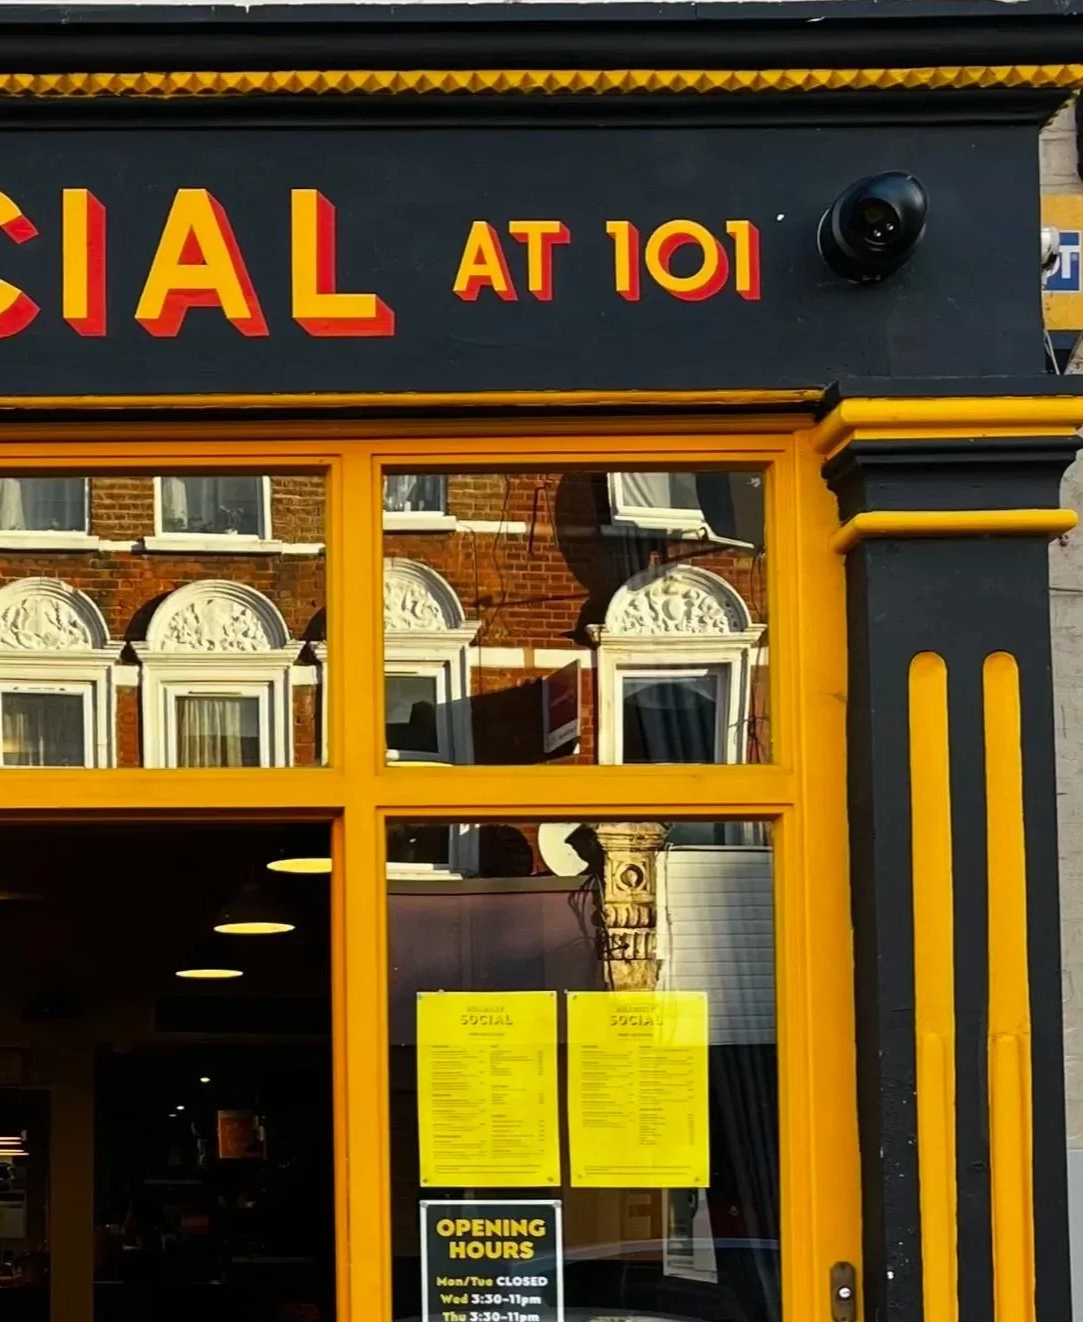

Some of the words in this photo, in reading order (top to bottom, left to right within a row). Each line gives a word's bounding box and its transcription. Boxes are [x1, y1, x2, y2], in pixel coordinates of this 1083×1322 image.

[453, 220, 570, 302] AT
[606, 219, 762, 302] 101
[461, 1013, 515, 1026] SOCIAL
[610, 1014, 664, 1026] SOCIAL
[436, 1218, 547, 1238] OPENING
[449, 1241, 535, 1259] HOURS
[436, 1276, 494, 1287] Mon/Tue
[496, 1276, 549, 1287] CLOSED
[440, 1294, 469, 1305] Wed
[470, 1294, 542, 1308] 3:30-11pm
[442, 1312, 467, 1322] Thu
